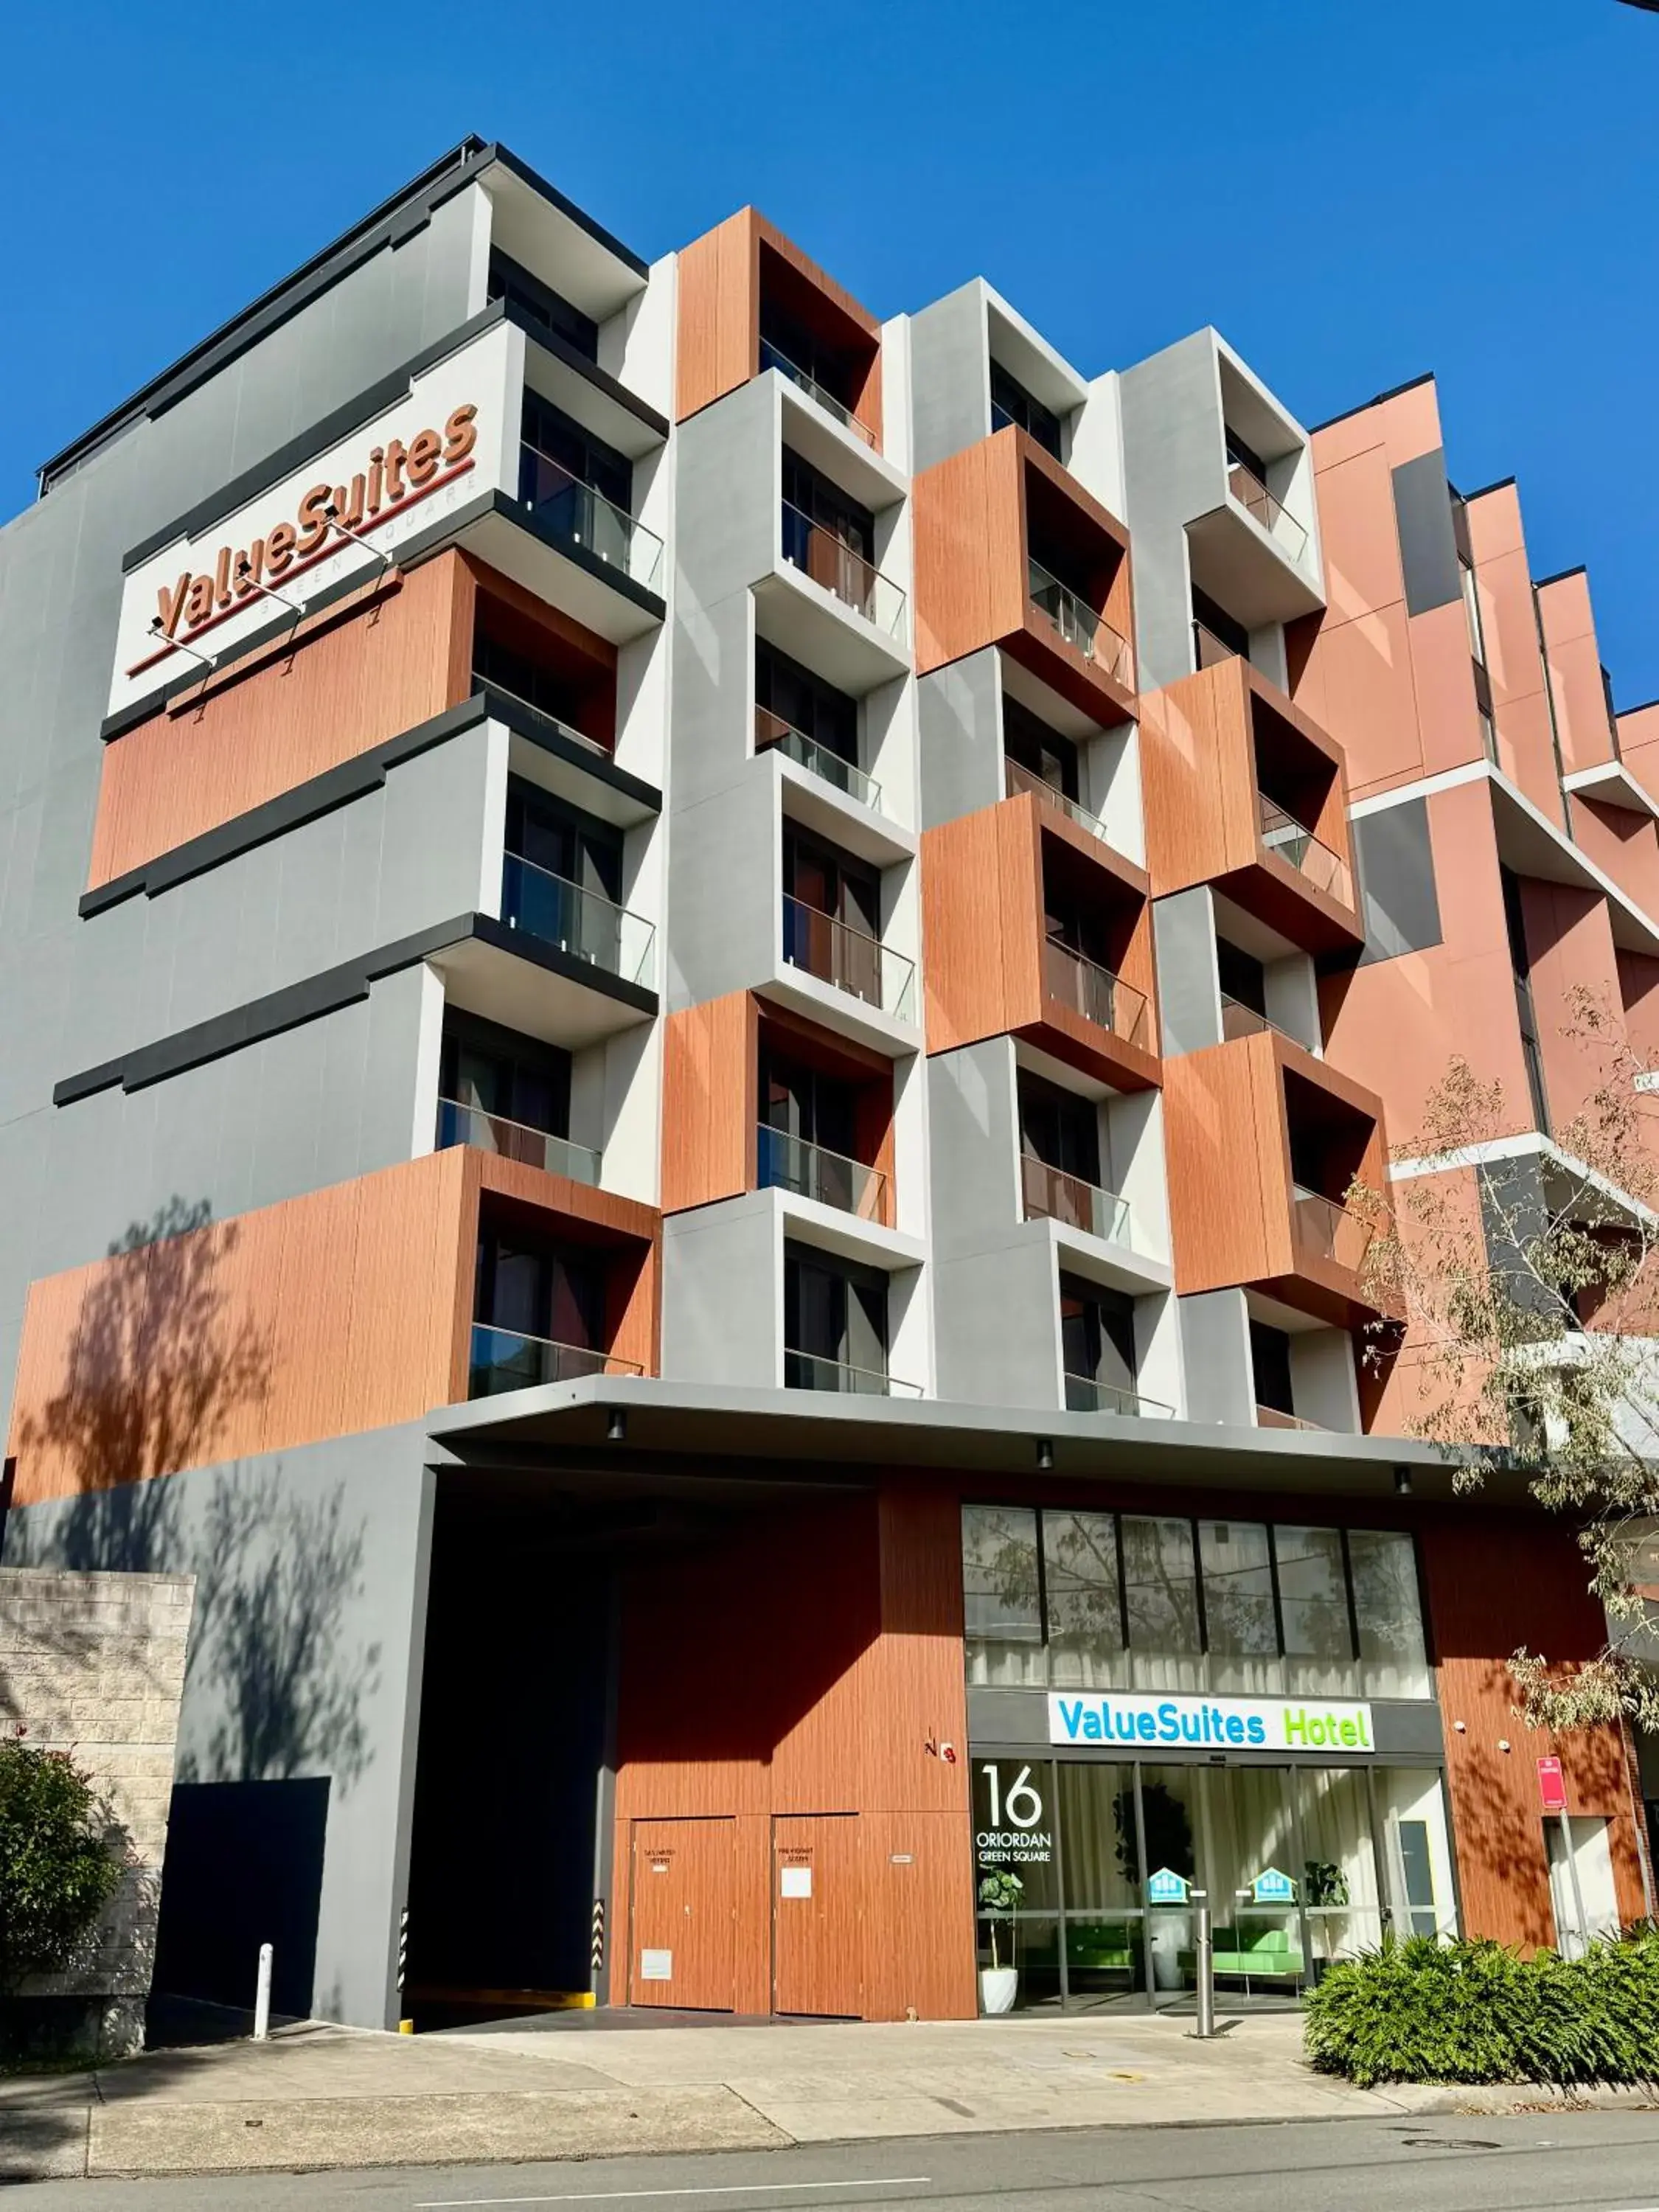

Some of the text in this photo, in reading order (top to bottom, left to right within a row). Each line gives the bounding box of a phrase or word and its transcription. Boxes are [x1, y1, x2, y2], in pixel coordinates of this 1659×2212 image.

[157, 403, 478, 640] ValueSuites
[1058, 1700, 1370, 1747] ValueSuites Hotel
[981, 1764, 1043, 1828] 16
[976, 1832, 1051, 1848] ORIORDAN
[978, 1850, 1051, 1863] GREEN SQUARE
